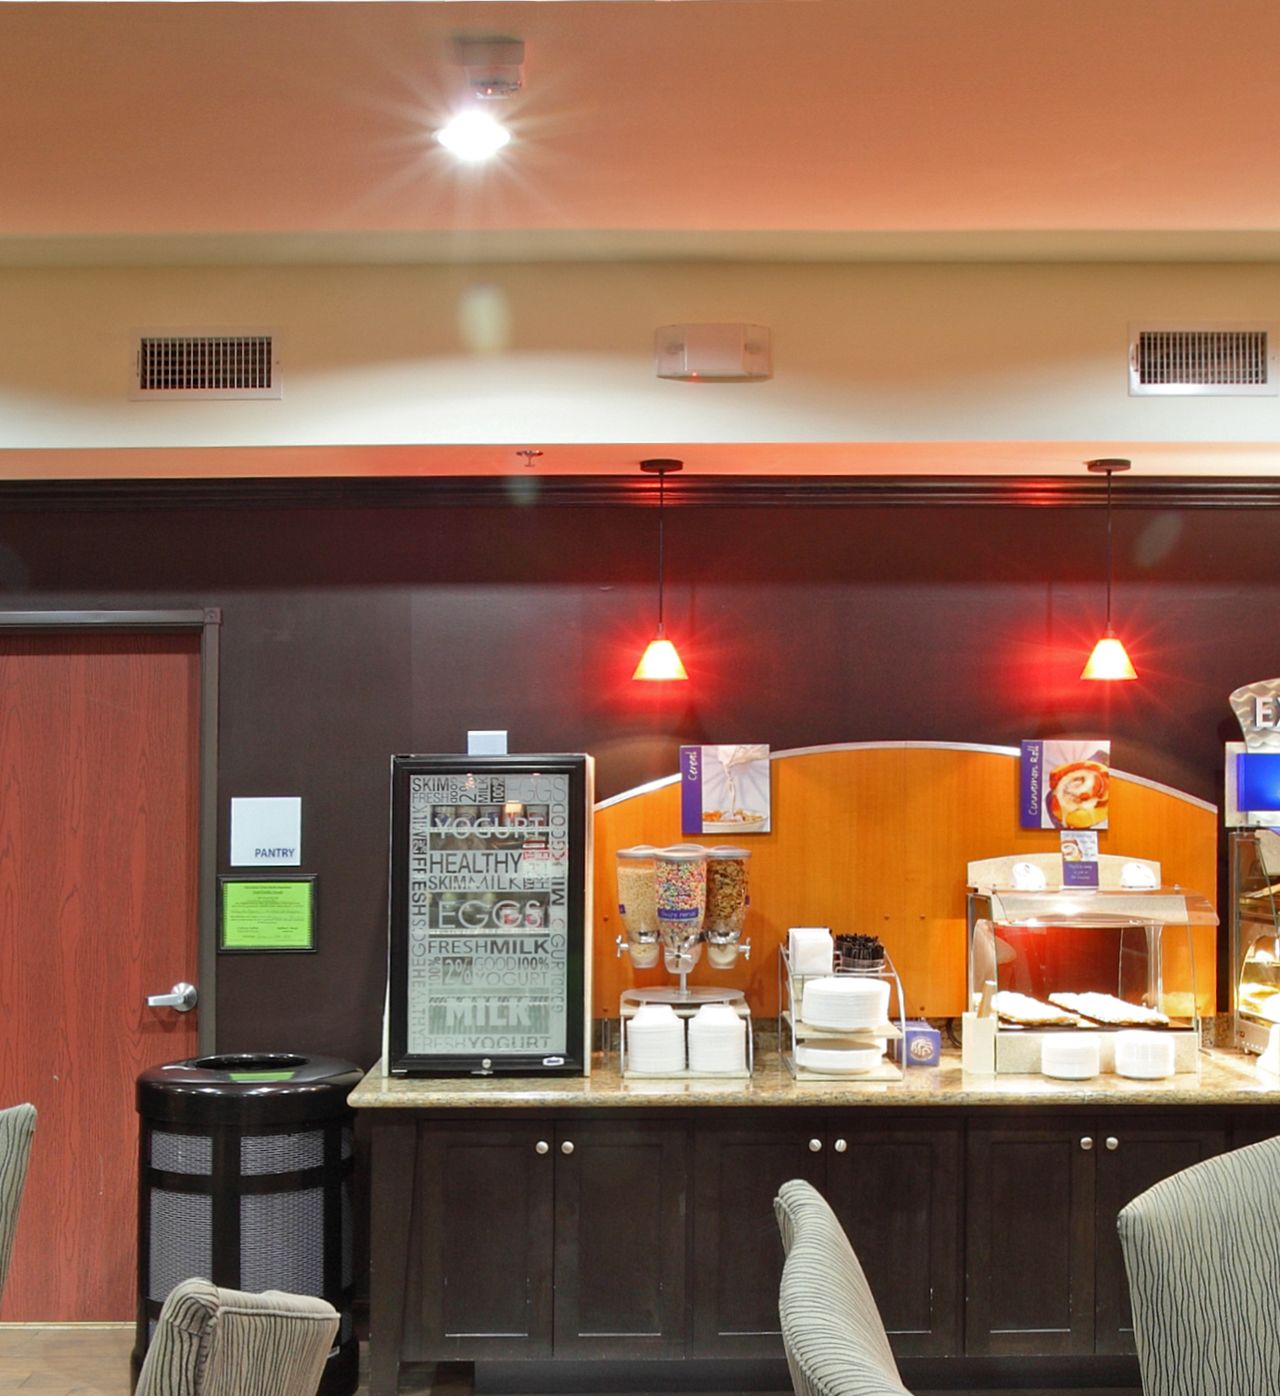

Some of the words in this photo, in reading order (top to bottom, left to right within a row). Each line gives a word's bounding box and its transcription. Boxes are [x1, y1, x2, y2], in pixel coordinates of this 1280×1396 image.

[1027, 745, 1039, 763] Roll
[685, 751, 698, 781] Cereal
[412, 777, 449, 792] SKIM
[478, 777, 489, 804] MILK
[435, 817, 545, 839] YOGURT
[254, 848, 295, 858] PANTRY
[430, 853, 522, 873] HEALTHY
[439, 900, 542, 929] EGGS
[428, 940, 488, 954] FRESH
[489, 940, 550, 954] MILK
[445, 958, 472, 985] 2%
[476, 972, 548, 986] YOGURT
[446, 997, 531, 1026] MILK
[468, 1037, 552, 1049] YOGURT
